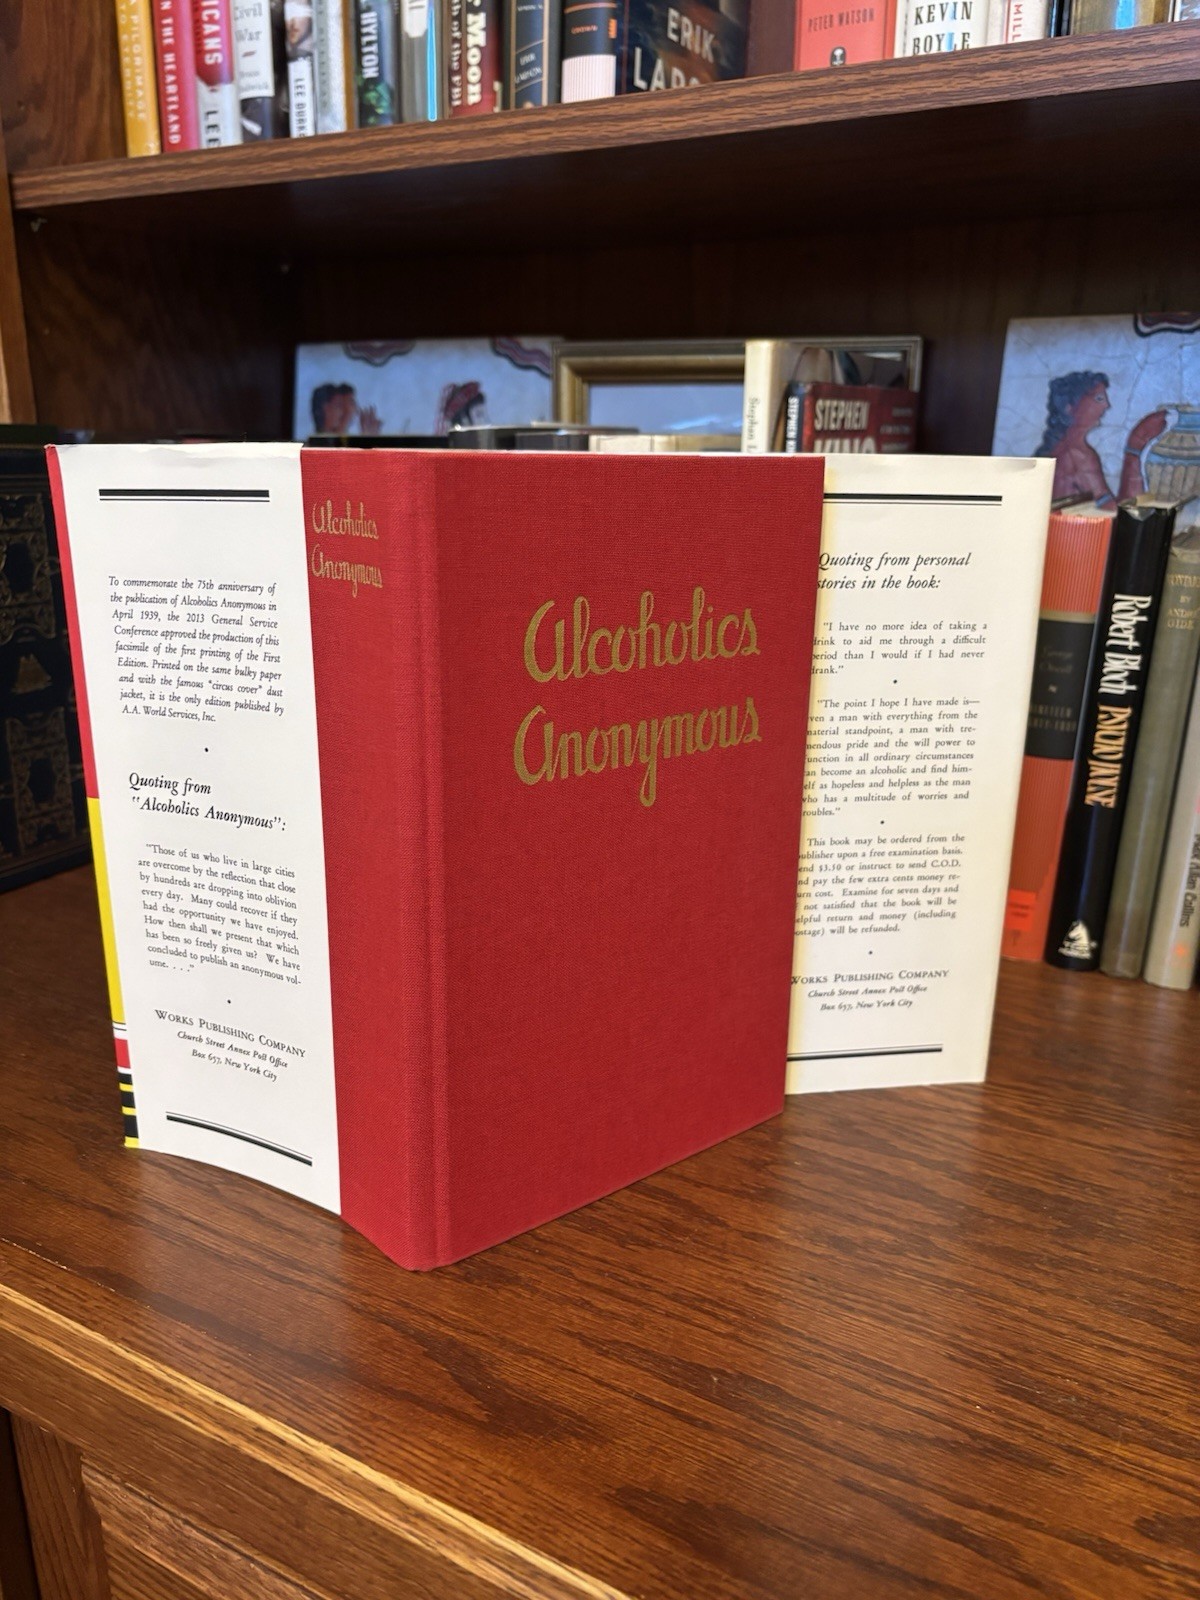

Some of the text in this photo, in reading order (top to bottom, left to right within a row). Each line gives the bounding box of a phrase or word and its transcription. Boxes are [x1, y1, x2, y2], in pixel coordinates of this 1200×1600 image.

[808, 8, 874, 32] PETER WATSON
[914, 2, 972, 25] KEVIN
[161, 17, 175, 46] THE
[234, 28, 262, 41] War
[667, 7, 714, 64] ERIK
[912, 32, 970, 55] BOYLE
[360, 12, 379, 79] HYLTON
[451, 42, 461, 70] the
[130, 14, 147, 120] PILGRIMAGE
[467, 12, 486, 105] Moon
[163, 53, 181, 144] HEARTLAND
[294, 78, 306, 98] LEE
[451, 75, 461, 106] FBI
[748, 397, 760, 441] Stephen
[786, 396, 800, 438] STEPHEN
[814, 399, 870, 431] STEPHEN
[312, 500, 379, 540] Alcoholics
[312, 543, 383, 598] Anonymous
[818, 552, 972, 572] Quoting from personal
[108, 576, 277, 596] To commemorate the 75th anniversary of
[861, 575, 876, 589] in
[881, 574, 902, 589] the
[906, 574, 941, 589] book:
[110, 592, 277, 612] the publication of Alcoholics Anonymous in
[112, 608, 278, 629] April 1939, the 2013 General Service
[839, 622, 860, 631] have
[910, 621, 927, 630] idea
[933, 620, 944, 630] of
[949, 621, 977, 632] taking
[114, 625, 280, 648] Conference approved the production of this
[524, 586, 761, 683] Alcoholics
[859, 636, 872, 645] aid
[899, 635, 934, 647] through
[952, 634, 986, 644] difficult
[1098, 594, 1152, 696] Robert Bloch
[114, 640, 280, 663] facsimile of the first printing of the First
[844, 650, 864, 660] than
[870, 650, 874, 659] I
[881, 650, 908, 659] would
[914, 649, 922, 658] if
[928, 650, 932, 658] I
[938, 649, 954, 658] had
[117, 656, 282, 682] Edition. Printed on the same bulky paper
[118, 672, 134, 683] and
[138, 674, 156, 684] with
[160, 675, 173, 686] the
[176, 676, 204, 689] famous
[266, 685, 283, 697] dust
[120, 688, 284, 716] jacket, it is the only edition published by
[122, 704, 216, 722] A.A. World Services, Inc.
[513, 697, 762, 807] Anonymous
[129, 772, 211, 796] Quoting from
[1179, 891, 1197, 927] Collins
[154, 1009, 306, 1058] WORKS PUBLISHING COMPANY
[269, 1056, 288, 1068] Office
[262, 1069, 277, 1082] City
